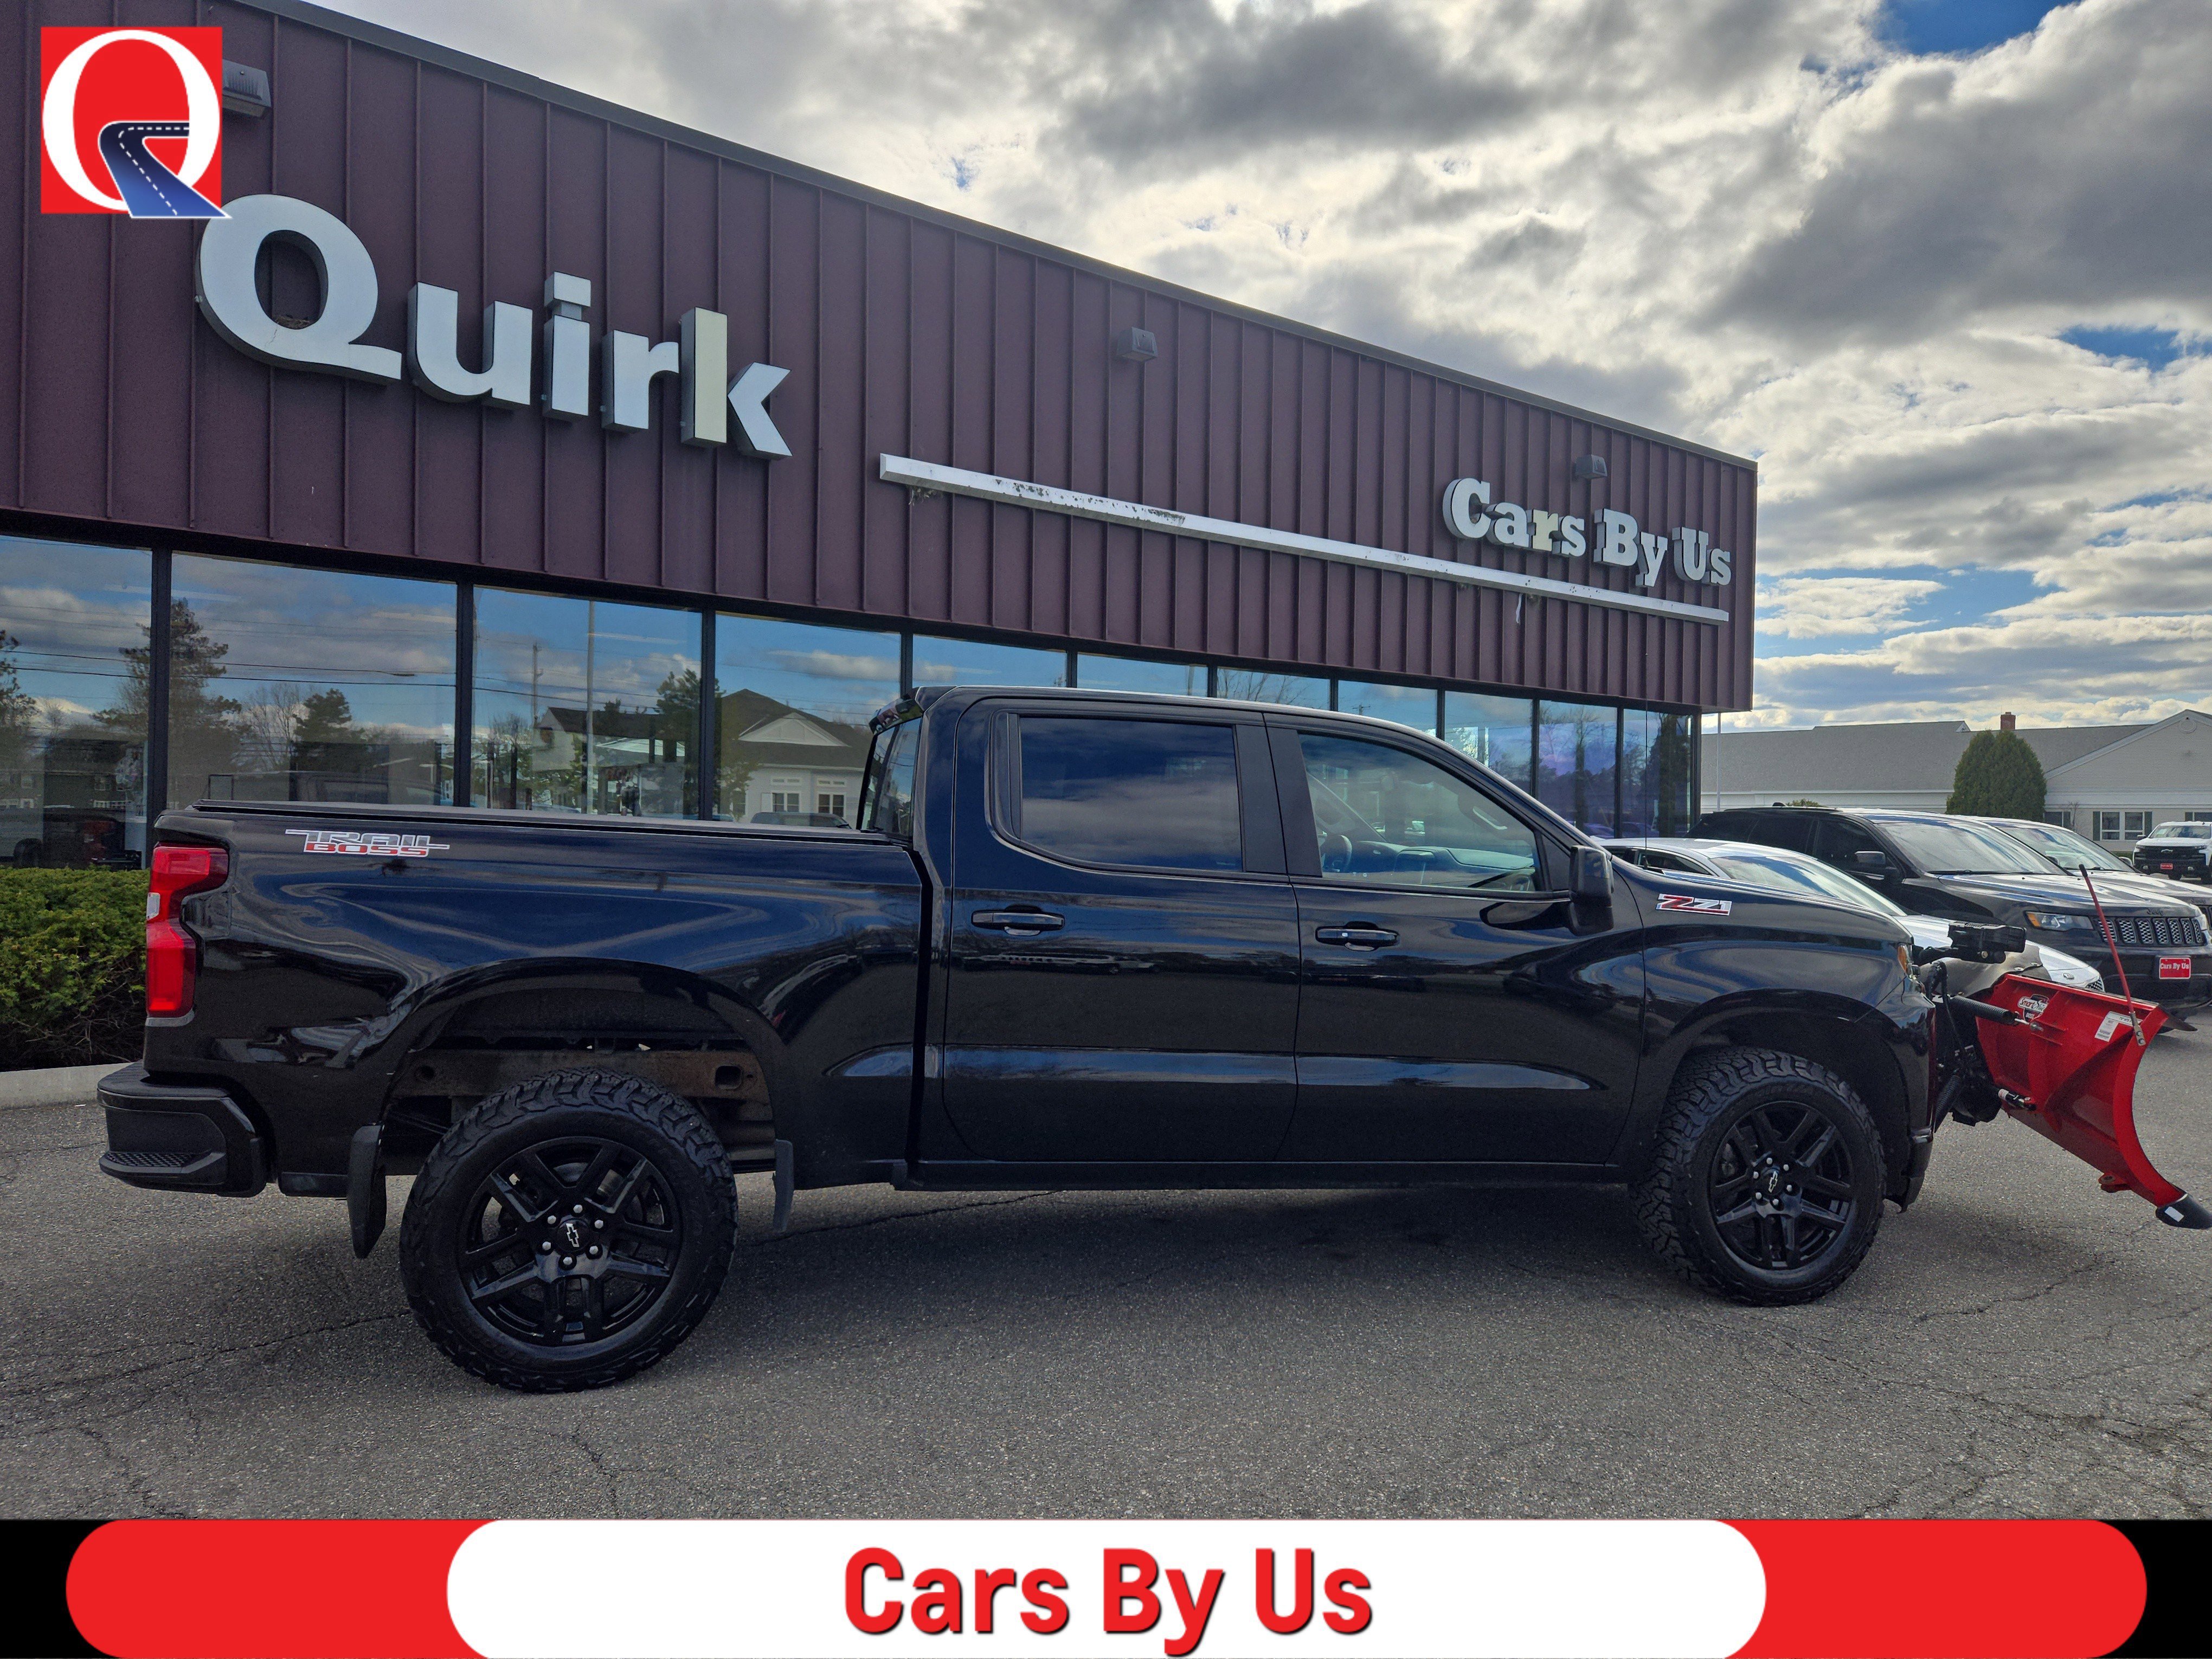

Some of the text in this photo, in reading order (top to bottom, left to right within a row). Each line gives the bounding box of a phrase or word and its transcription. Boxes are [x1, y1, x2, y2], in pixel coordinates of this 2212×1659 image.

[195, 193, 793, 461] Quirk
[1443, 478, 1731, 587] Cars By Us
[285, 829, 450, 850] TRAIL
[304, 841, 430, 858] BOSS
[1655, 893, 1732, 916] Z71
